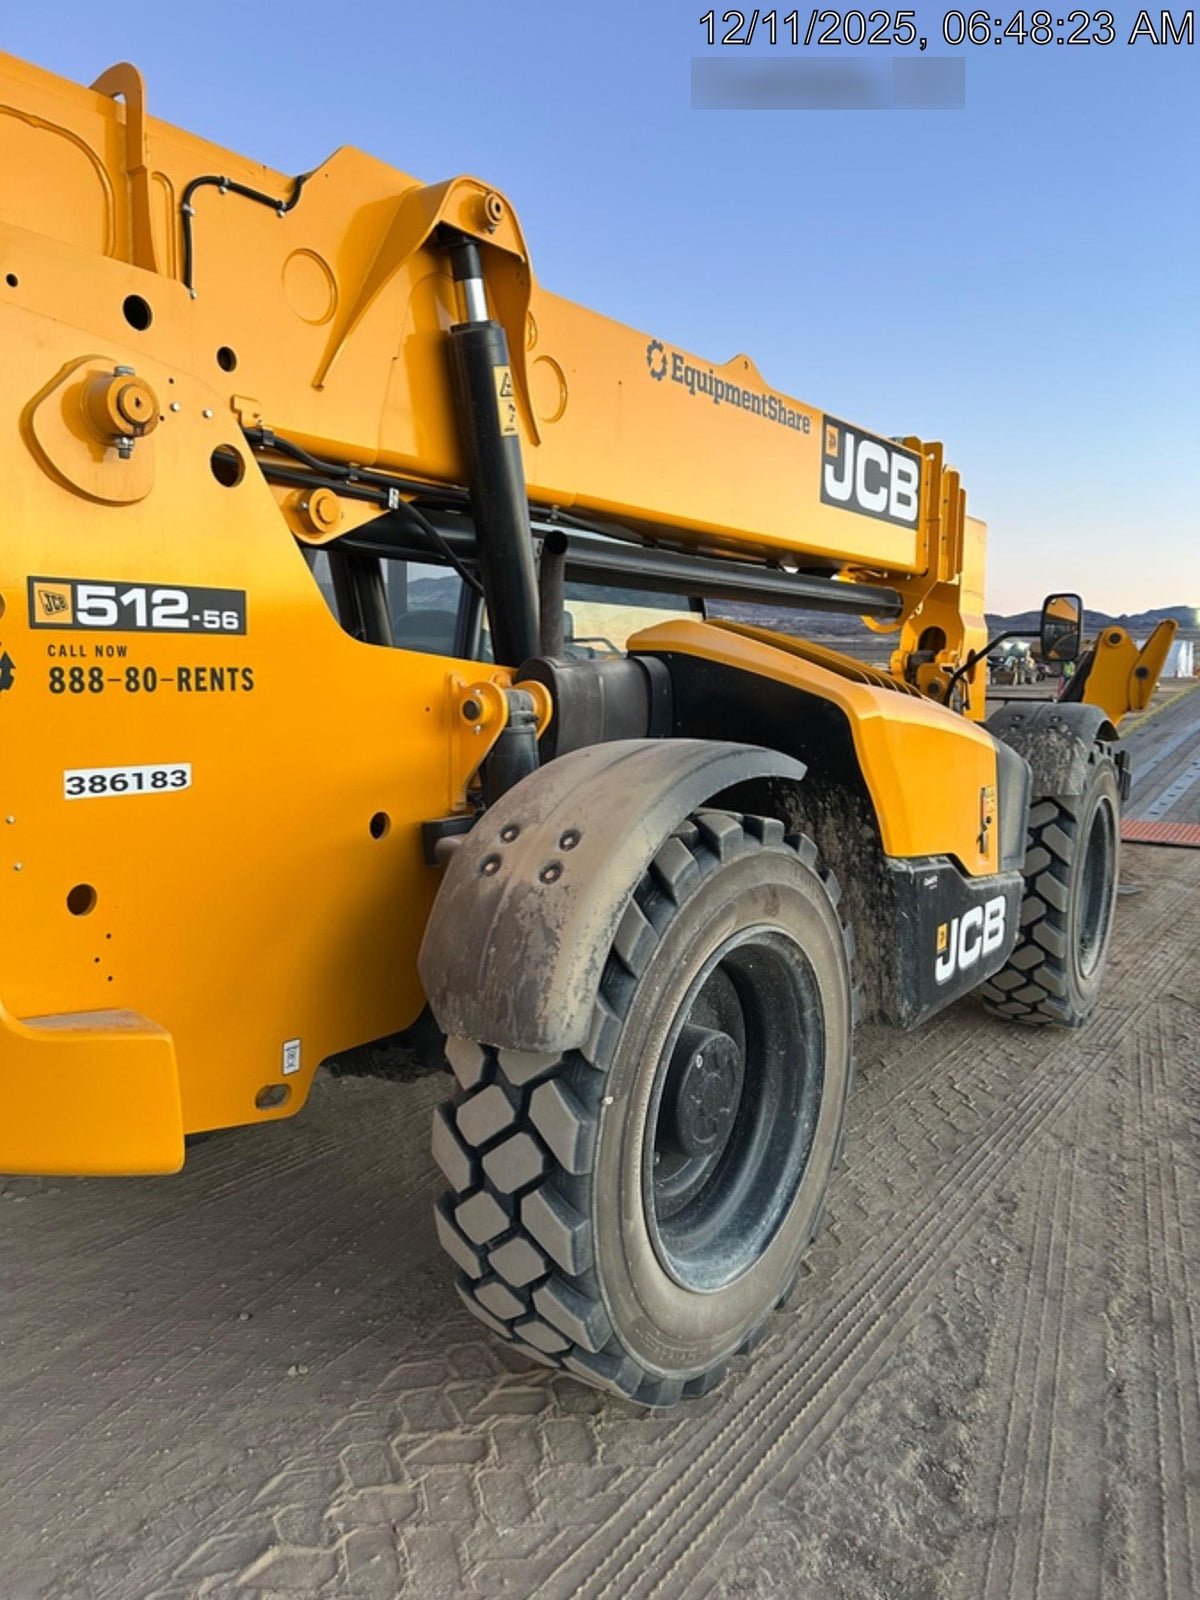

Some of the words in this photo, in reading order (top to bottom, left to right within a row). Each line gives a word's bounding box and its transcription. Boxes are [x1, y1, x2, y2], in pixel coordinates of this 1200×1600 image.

[671, 352, 810, 434] EquipmentShare
[823, 431, 920, 523] JCB
[47, 644, 87, 657] CALL
[95, 645, 128, 657] NOW
[48, 666, 255, 694] 888-80-RENTS
[65, 769, 188, 796] 386183
[935, 895, 1006, 985] JCB
